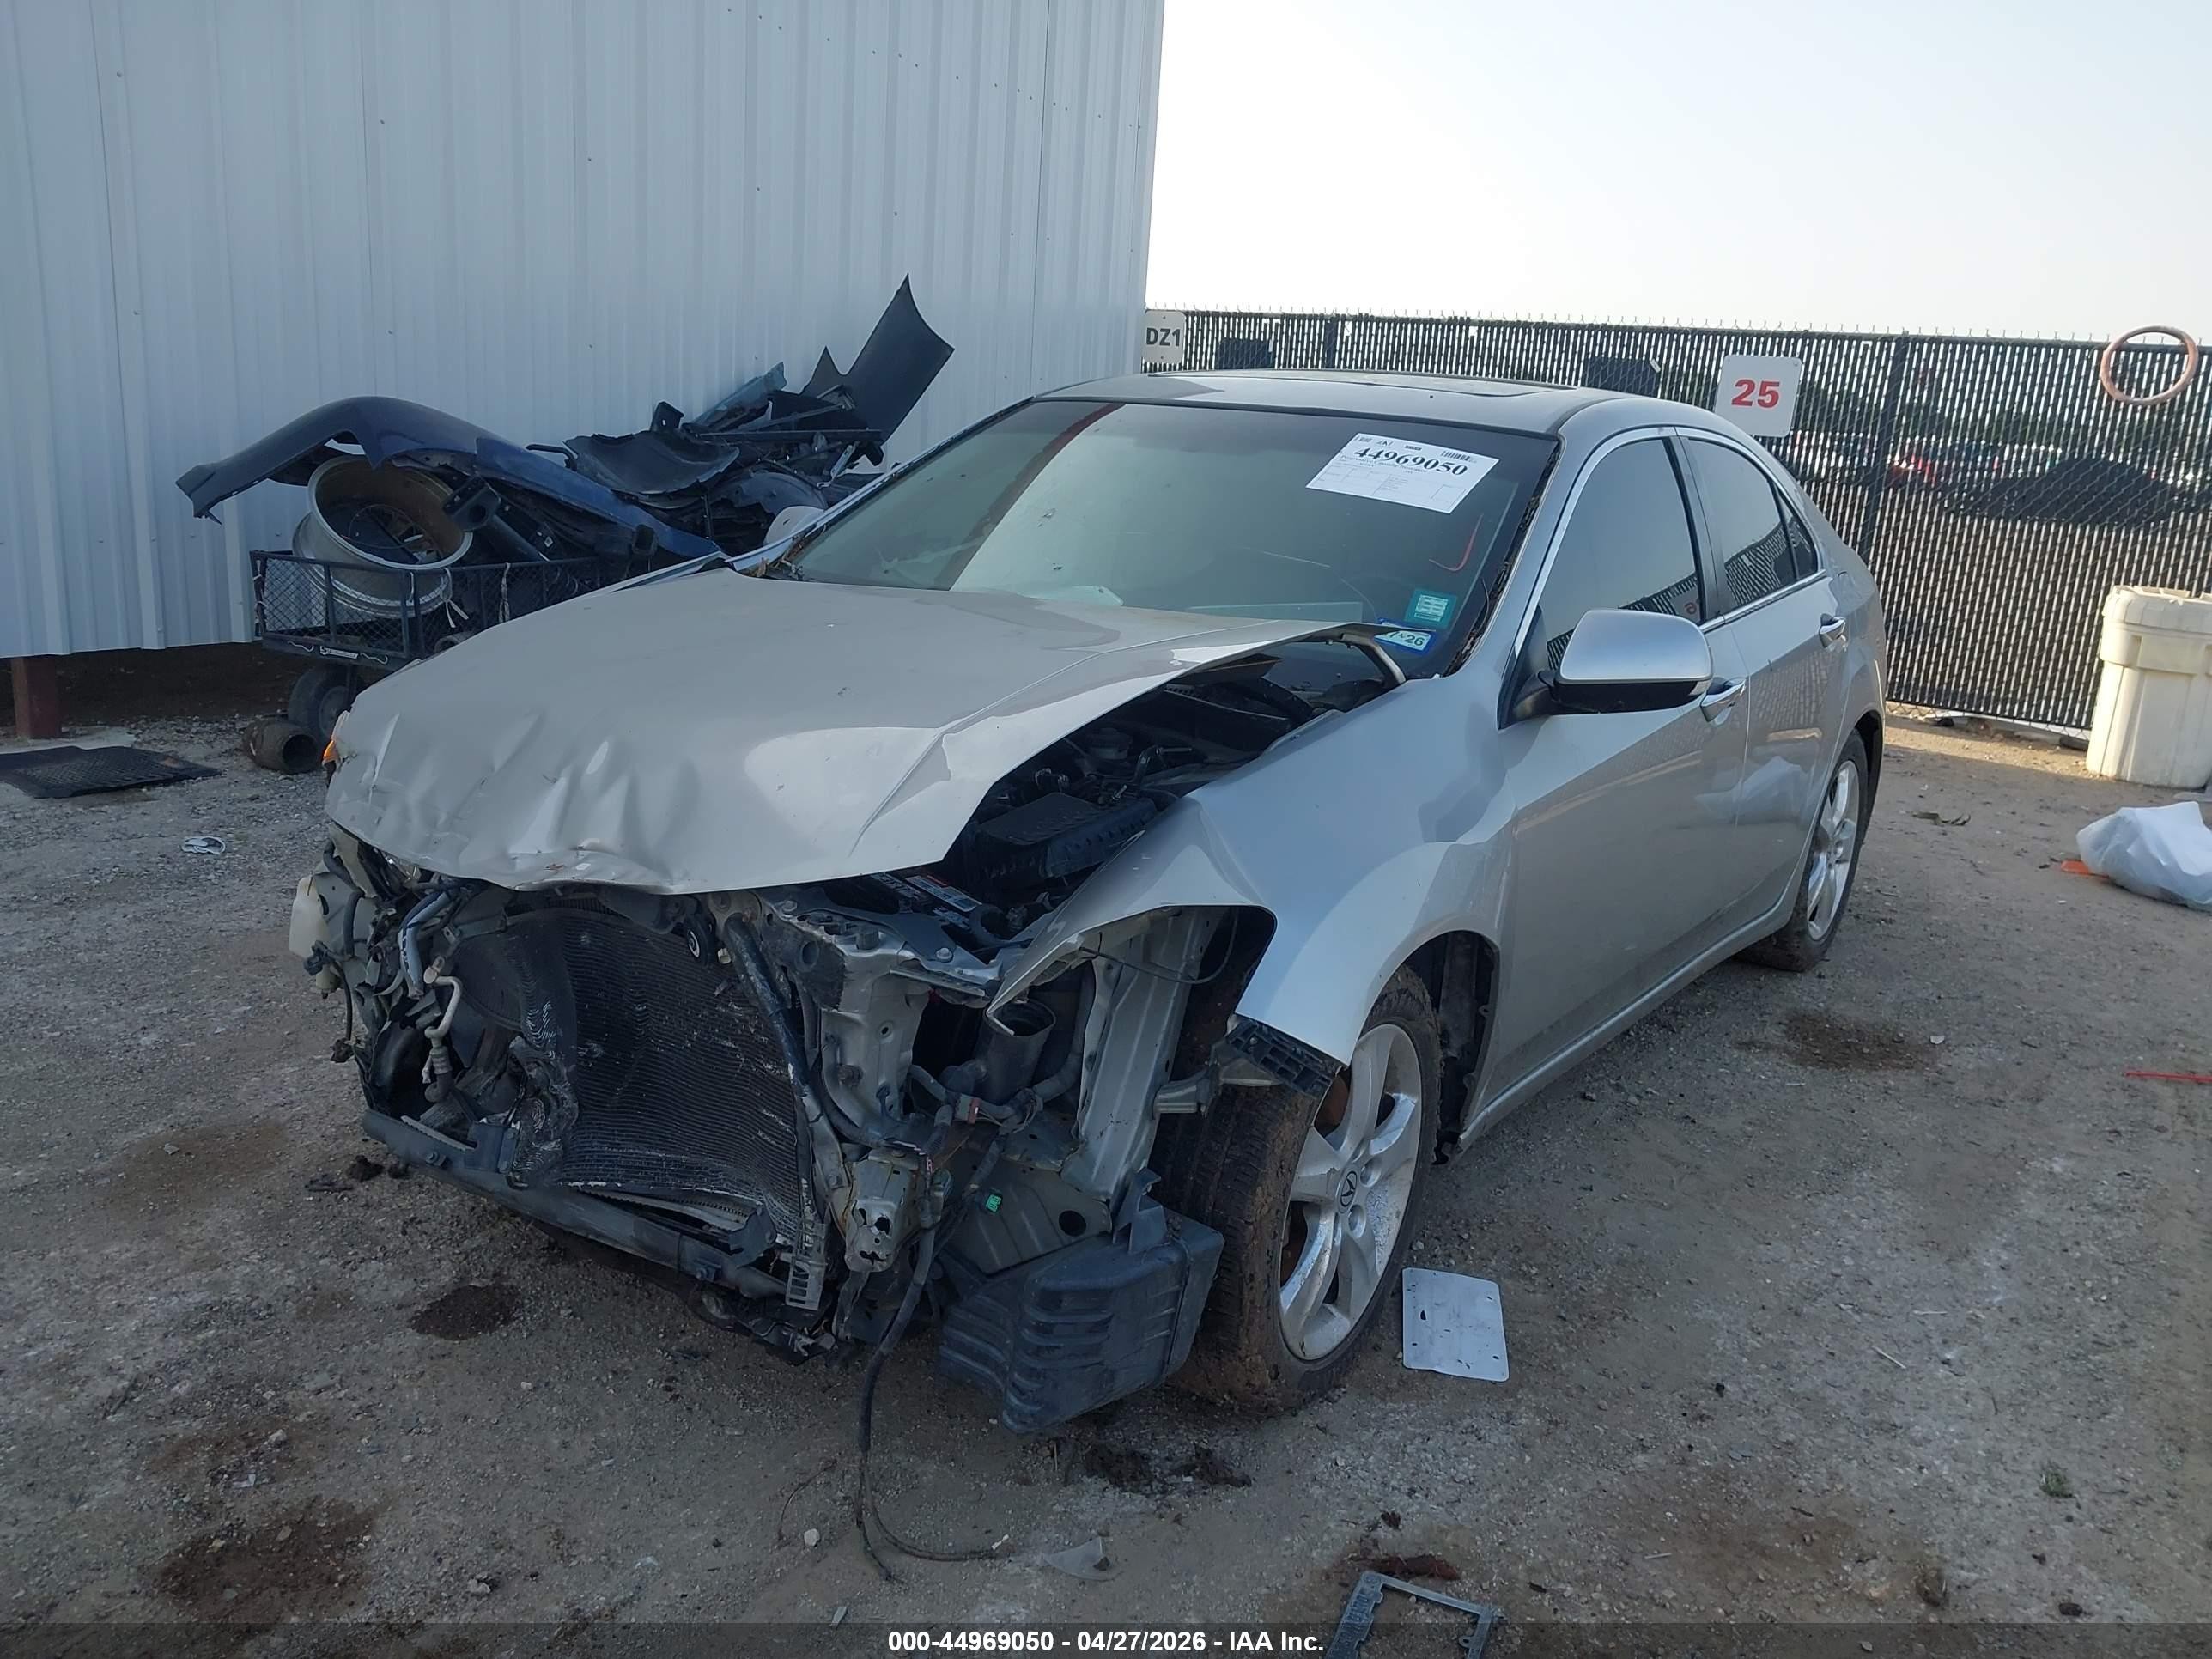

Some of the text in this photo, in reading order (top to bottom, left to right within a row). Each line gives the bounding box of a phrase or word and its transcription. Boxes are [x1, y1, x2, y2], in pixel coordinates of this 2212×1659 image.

[1146, 326, 1181, 348] DZ1
[1731, 379, 1779, 408] 25
[1354, 447, 1468, 476] 44969050
[1404, 633, 1425, 647] 26
